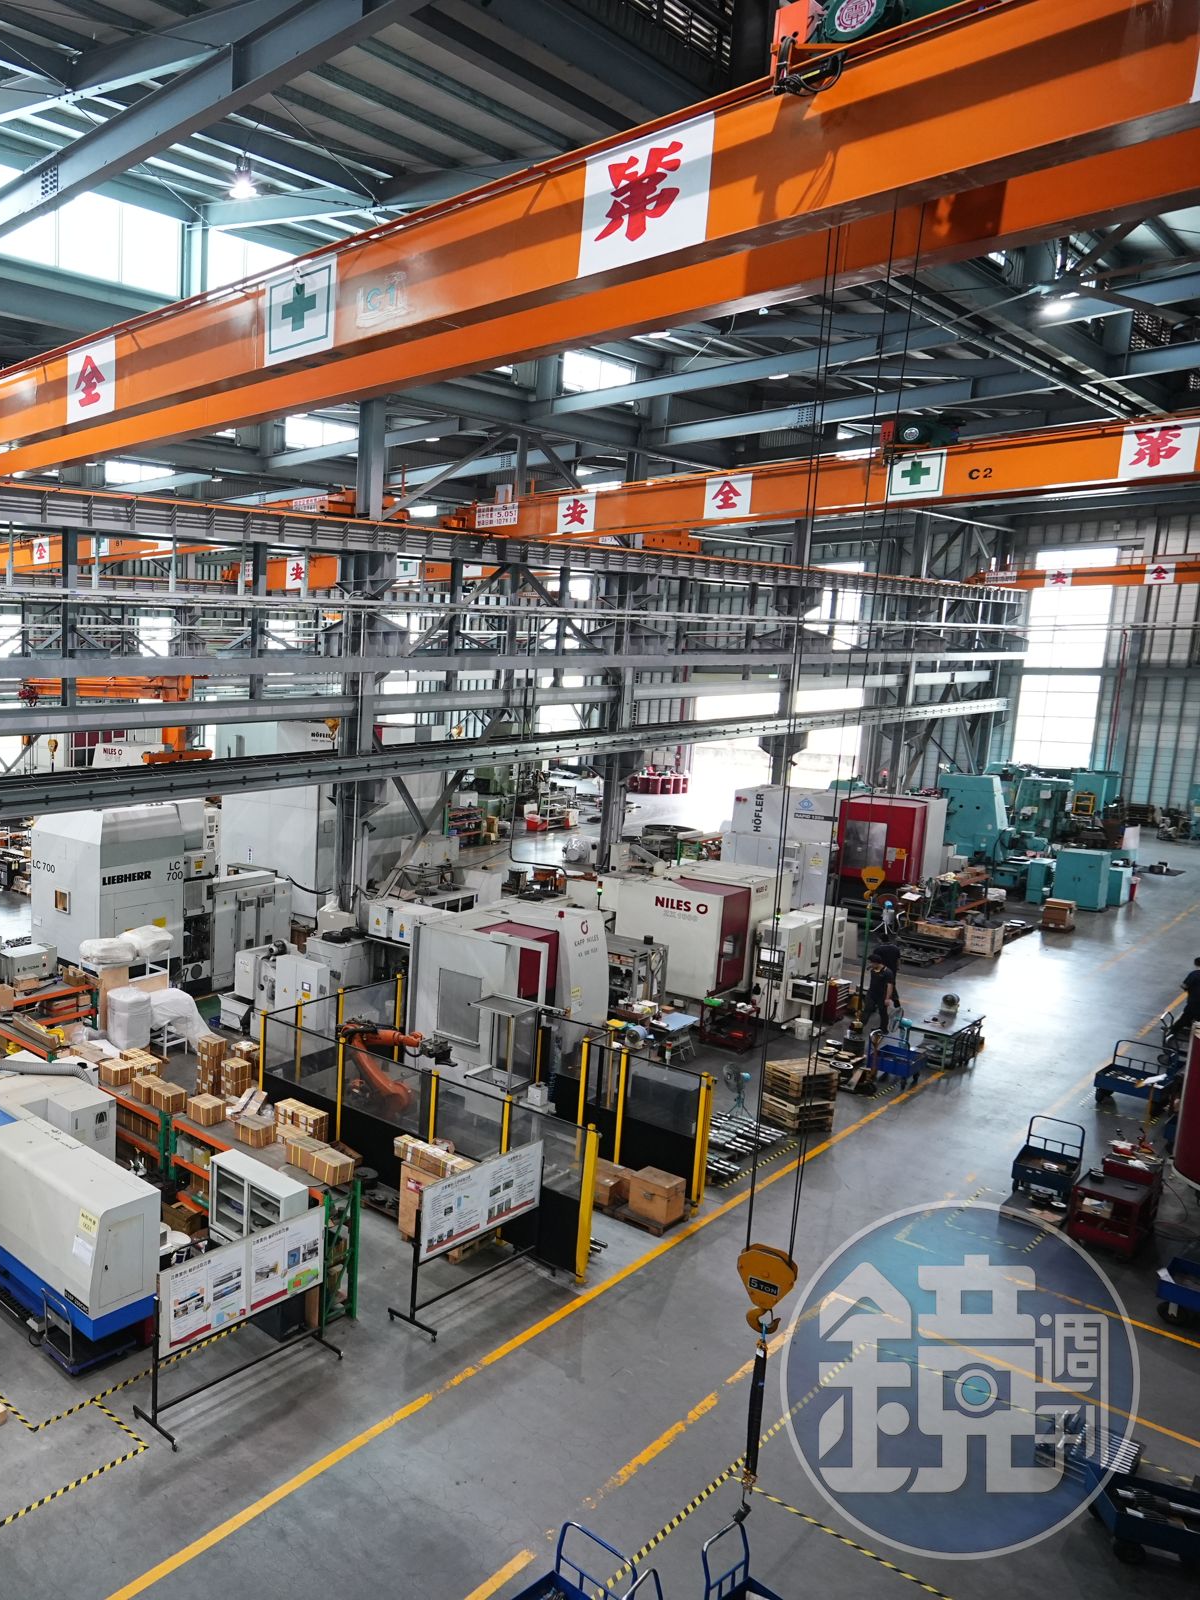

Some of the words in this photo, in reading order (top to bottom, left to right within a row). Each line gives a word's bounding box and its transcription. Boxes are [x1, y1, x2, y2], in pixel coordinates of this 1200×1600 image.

[74, 354, 106, 408] 全
[594, 140, 683, 242] 第
[562, 499, 588, 526] 安
[711, 480, 742, 509] 全
[1128, 425, 1183, 468] 第
[968, 467, 993, 480] C2
[35, 542, 46, 559] 全
[290, 562, 304, 582] 安
[1049, 570, 1068, 585] 安
[1150, 565, 1169, 580] 全
[753, 793, 764, 832] HÖFLER
[32, 859, 41, 870] LC
[42, 862, 56, 874] 700
[169, 861, 181, 871] LC
[102, 870, 152, 886] LIEBHERR
[166, 870, 184, 881] 700
[655, 896, 692, 912] NILES
[750, 1280, 758, 1288] 5
[760, 1284, 778, 1295] TON
